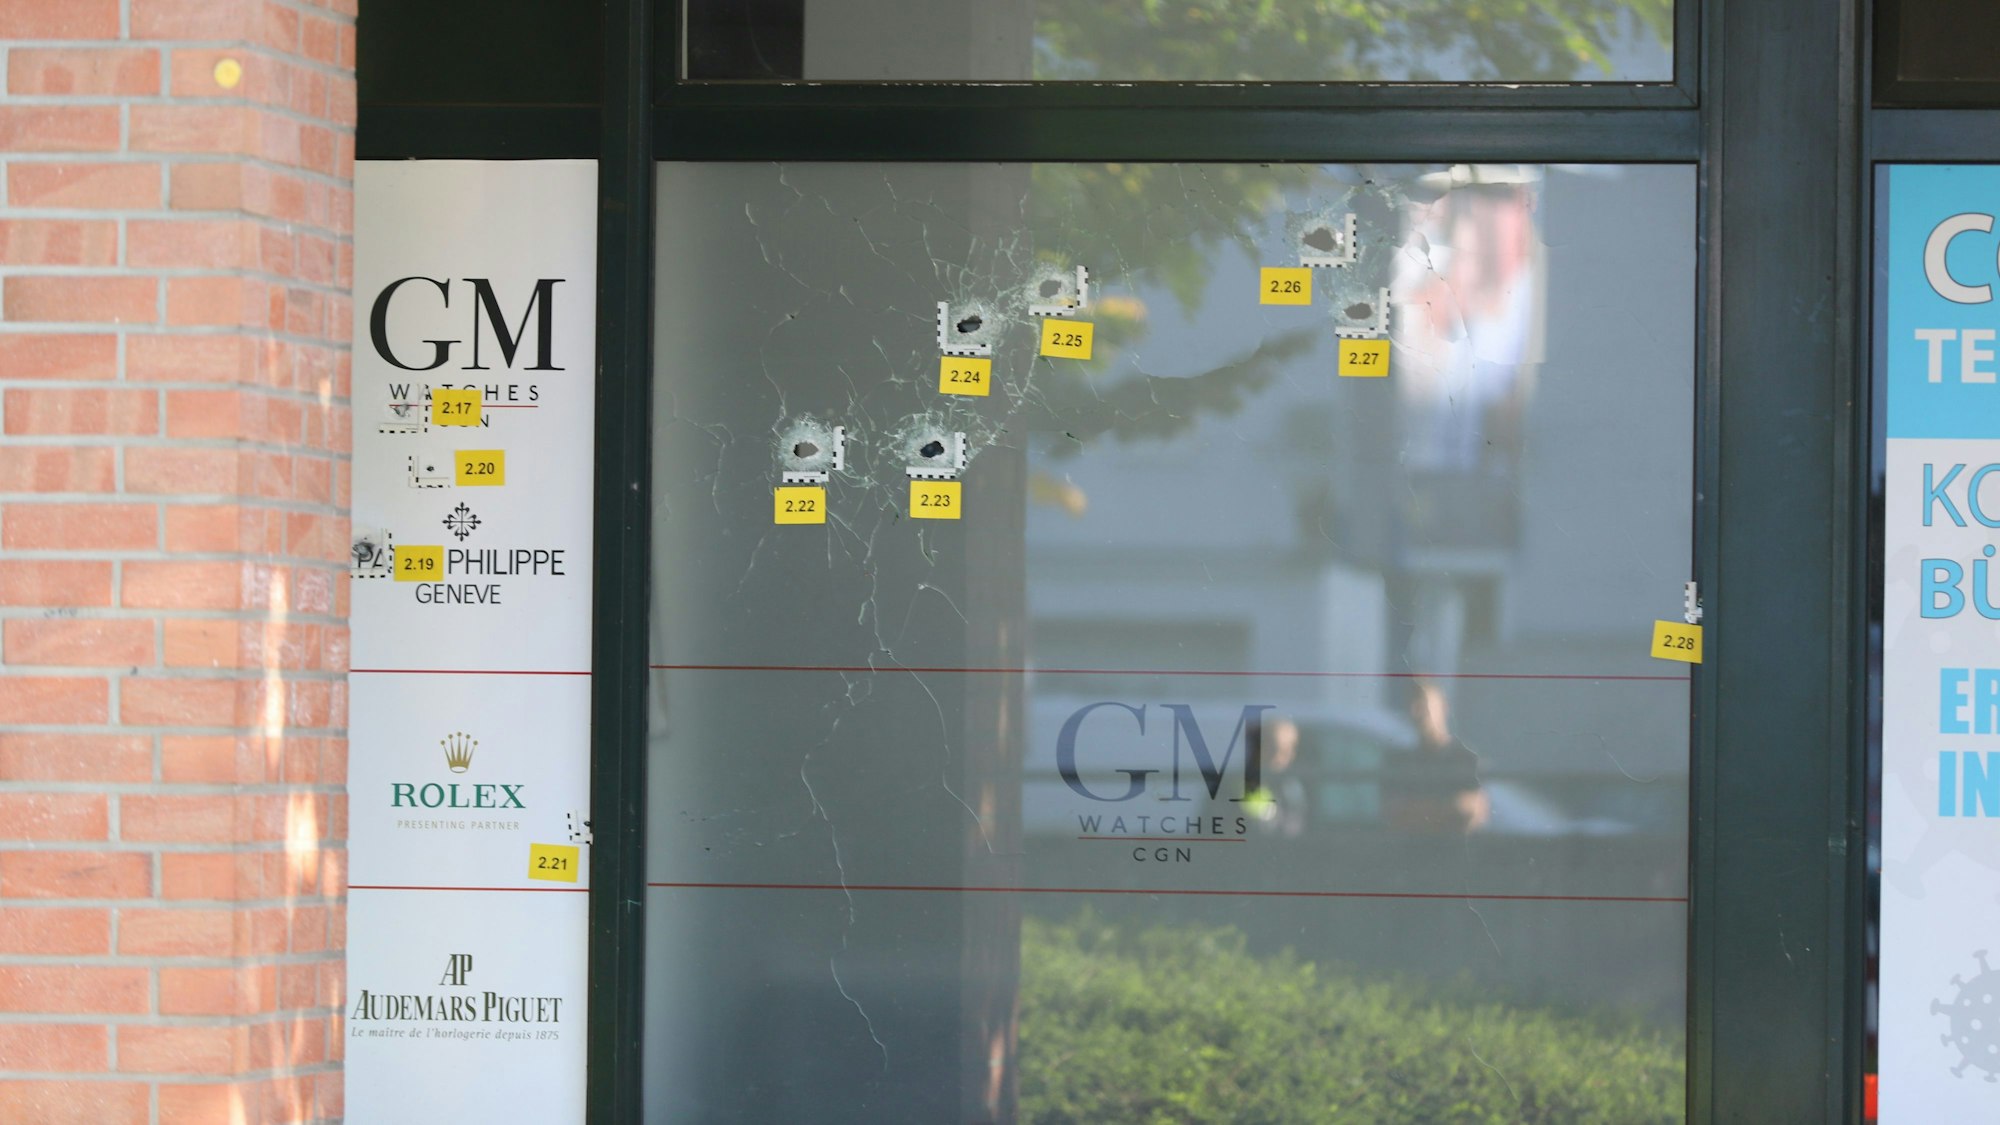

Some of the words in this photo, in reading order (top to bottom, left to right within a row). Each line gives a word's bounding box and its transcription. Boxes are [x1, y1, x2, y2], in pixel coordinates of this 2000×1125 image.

[1923, 212, 2000, 305] C
[1270, 280, 1301, 293] 2.26
[370, 276, 566, 371] GM
[1052, 333, 1082, 347] 2.25
[1349, 352, 1379, 365] 2.27
[1914, 328, 1997, 384] TE
[950, 370, 980, 383] 2.24
[389, 383, 539, 401] WAHES
[442, 401, 472, 414] 2.17
[465, 462, 495, 475] 2.20
[785, 500, 815, 513] 2.22
[920, 494, 951, 507] 2.23
[404, 558, 434, 571] 2.19
[448, 549, 565, 575] PHILIPPE
[415, 583, 501, 604] GENEVE
[1663, 634, 1695, 650] 2.28
[1056, 702, 1277, 802] GM
[1938, 751, 2000, 817] IN
[390, 783, 526, 808] ROLEX
[397, 820, 465, 830] PRESENTING
[471, 821, 520, 830] PARTNER
[1078, 815, 1247, 834] WATCHES
[1132, 847, 1191, 862] CGN
[538, 856, 567, 870] 2.21
[438, 953, 473, 986] AP
[351, 1027, 364, 1037] Le
[409, 1027, 422, 1038] de
[495, 1029, 531, 1041] depuis
[535, 1030, 560, 1040] 1875
